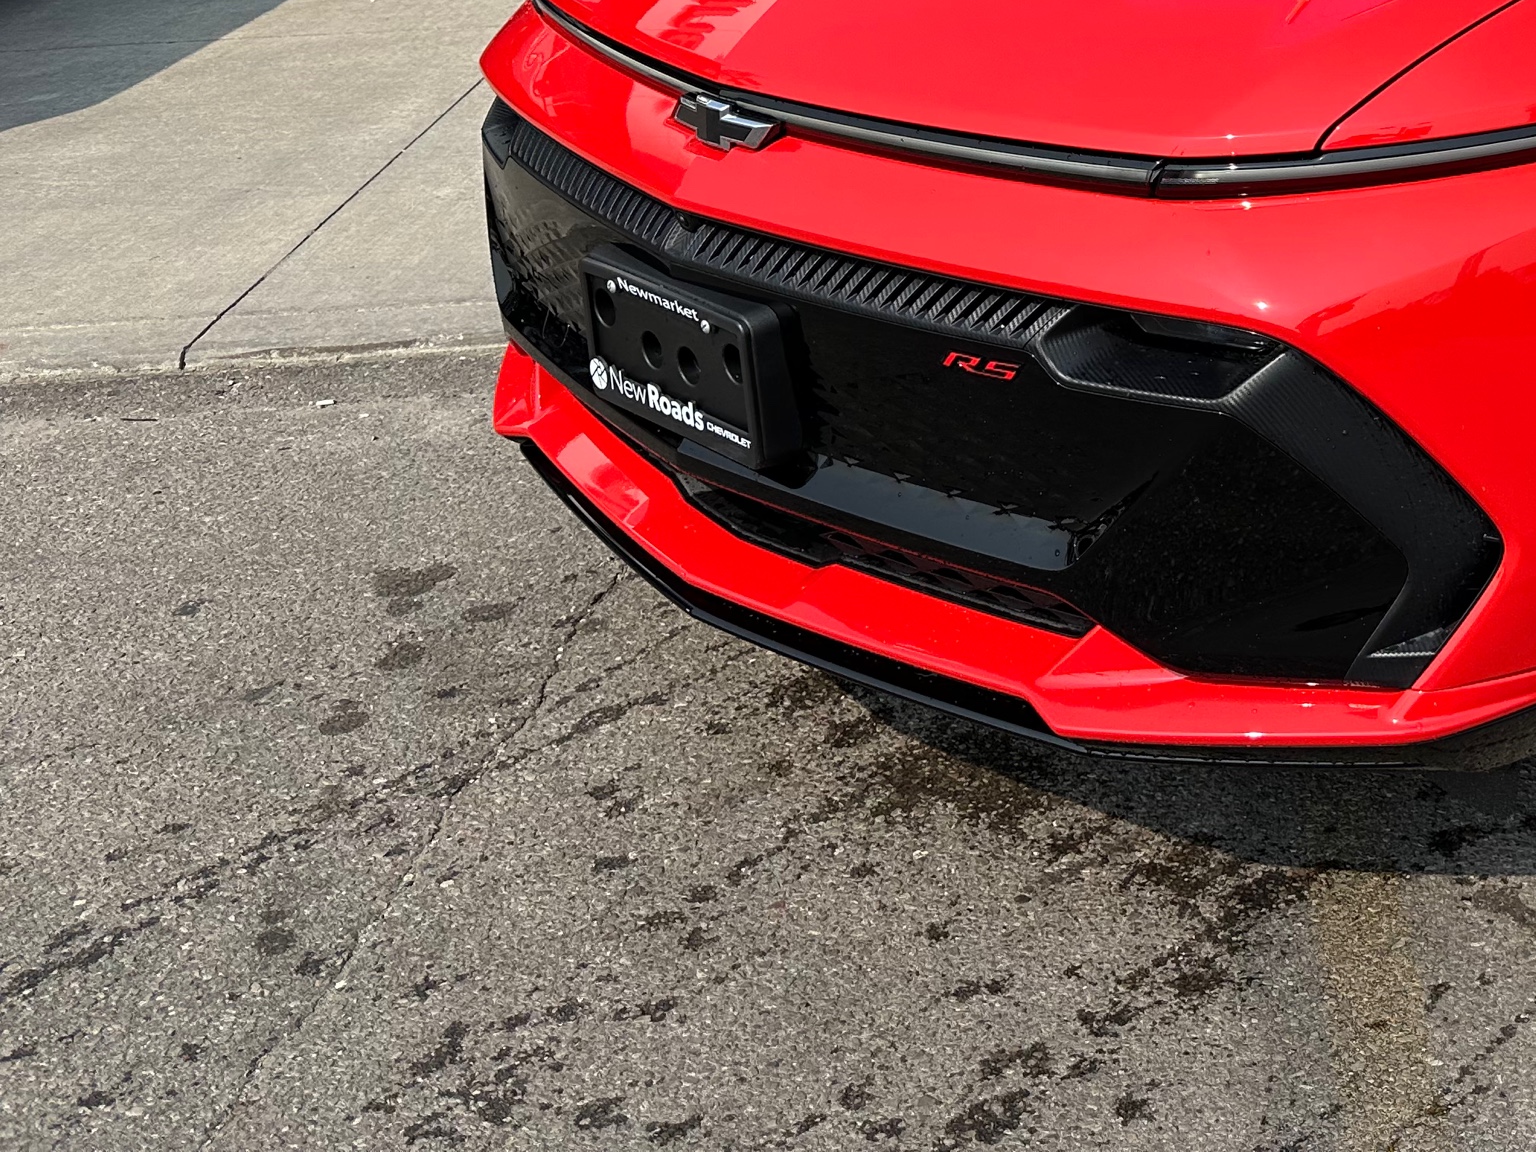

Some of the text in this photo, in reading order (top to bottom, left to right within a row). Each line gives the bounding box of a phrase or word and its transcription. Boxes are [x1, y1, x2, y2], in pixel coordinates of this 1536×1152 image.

[617, 276, 699, 322] Newmarket
[943, 351, 1017, 381] RS
[609, 365, 751, 449] NewRoads CHEVROLET
